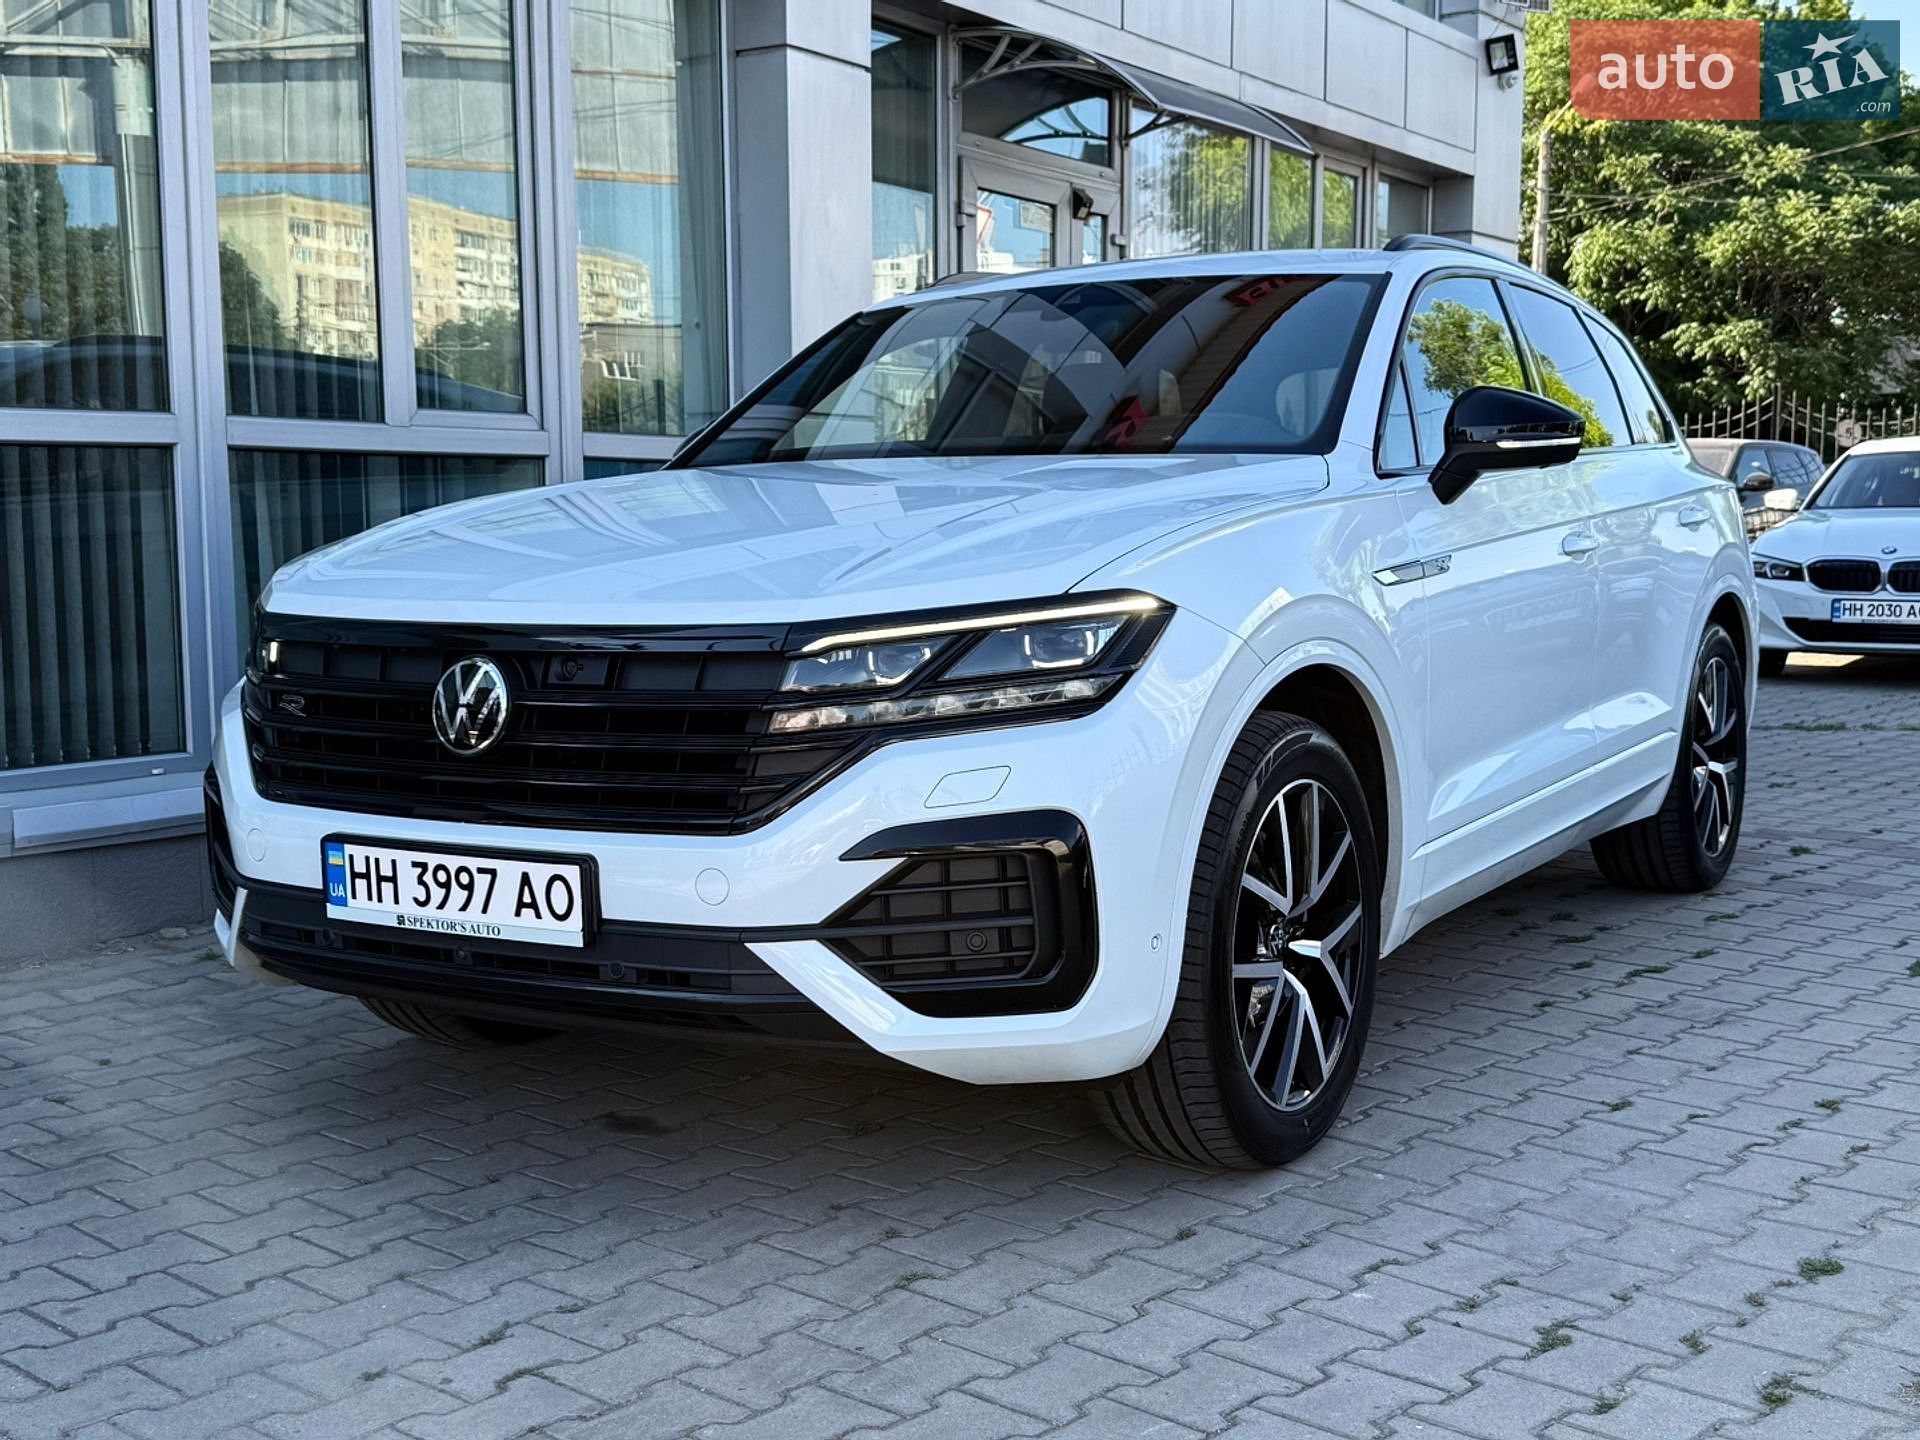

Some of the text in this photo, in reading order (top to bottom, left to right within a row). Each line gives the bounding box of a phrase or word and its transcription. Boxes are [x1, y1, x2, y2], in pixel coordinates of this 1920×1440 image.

[1842, 602, 1920, 619] HH 2030 A
[329, 885, 346, 898] UA
[348, 853, 575, 923] HH 3997 AO
[406, 915, 501, 938] SPEKTOR'S AUTO
